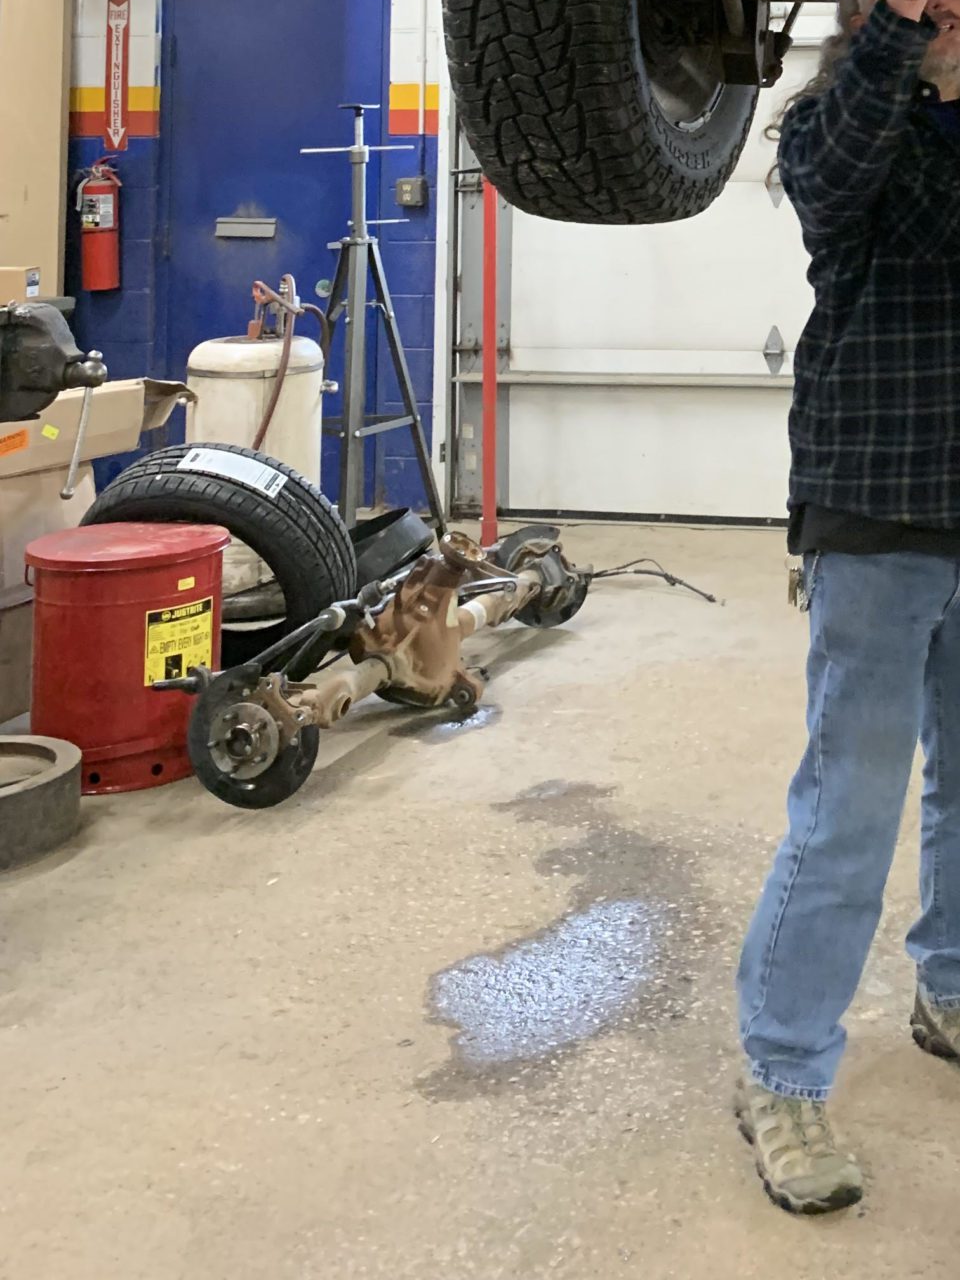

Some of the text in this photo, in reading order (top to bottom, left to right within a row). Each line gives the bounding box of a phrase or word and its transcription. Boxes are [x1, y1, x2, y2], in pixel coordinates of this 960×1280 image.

[109, 10, 127, 20] FIRE
[113, 24, 121, 137] EXTINGUISHER
[171, 603, 203, 619] JUSTRITE
